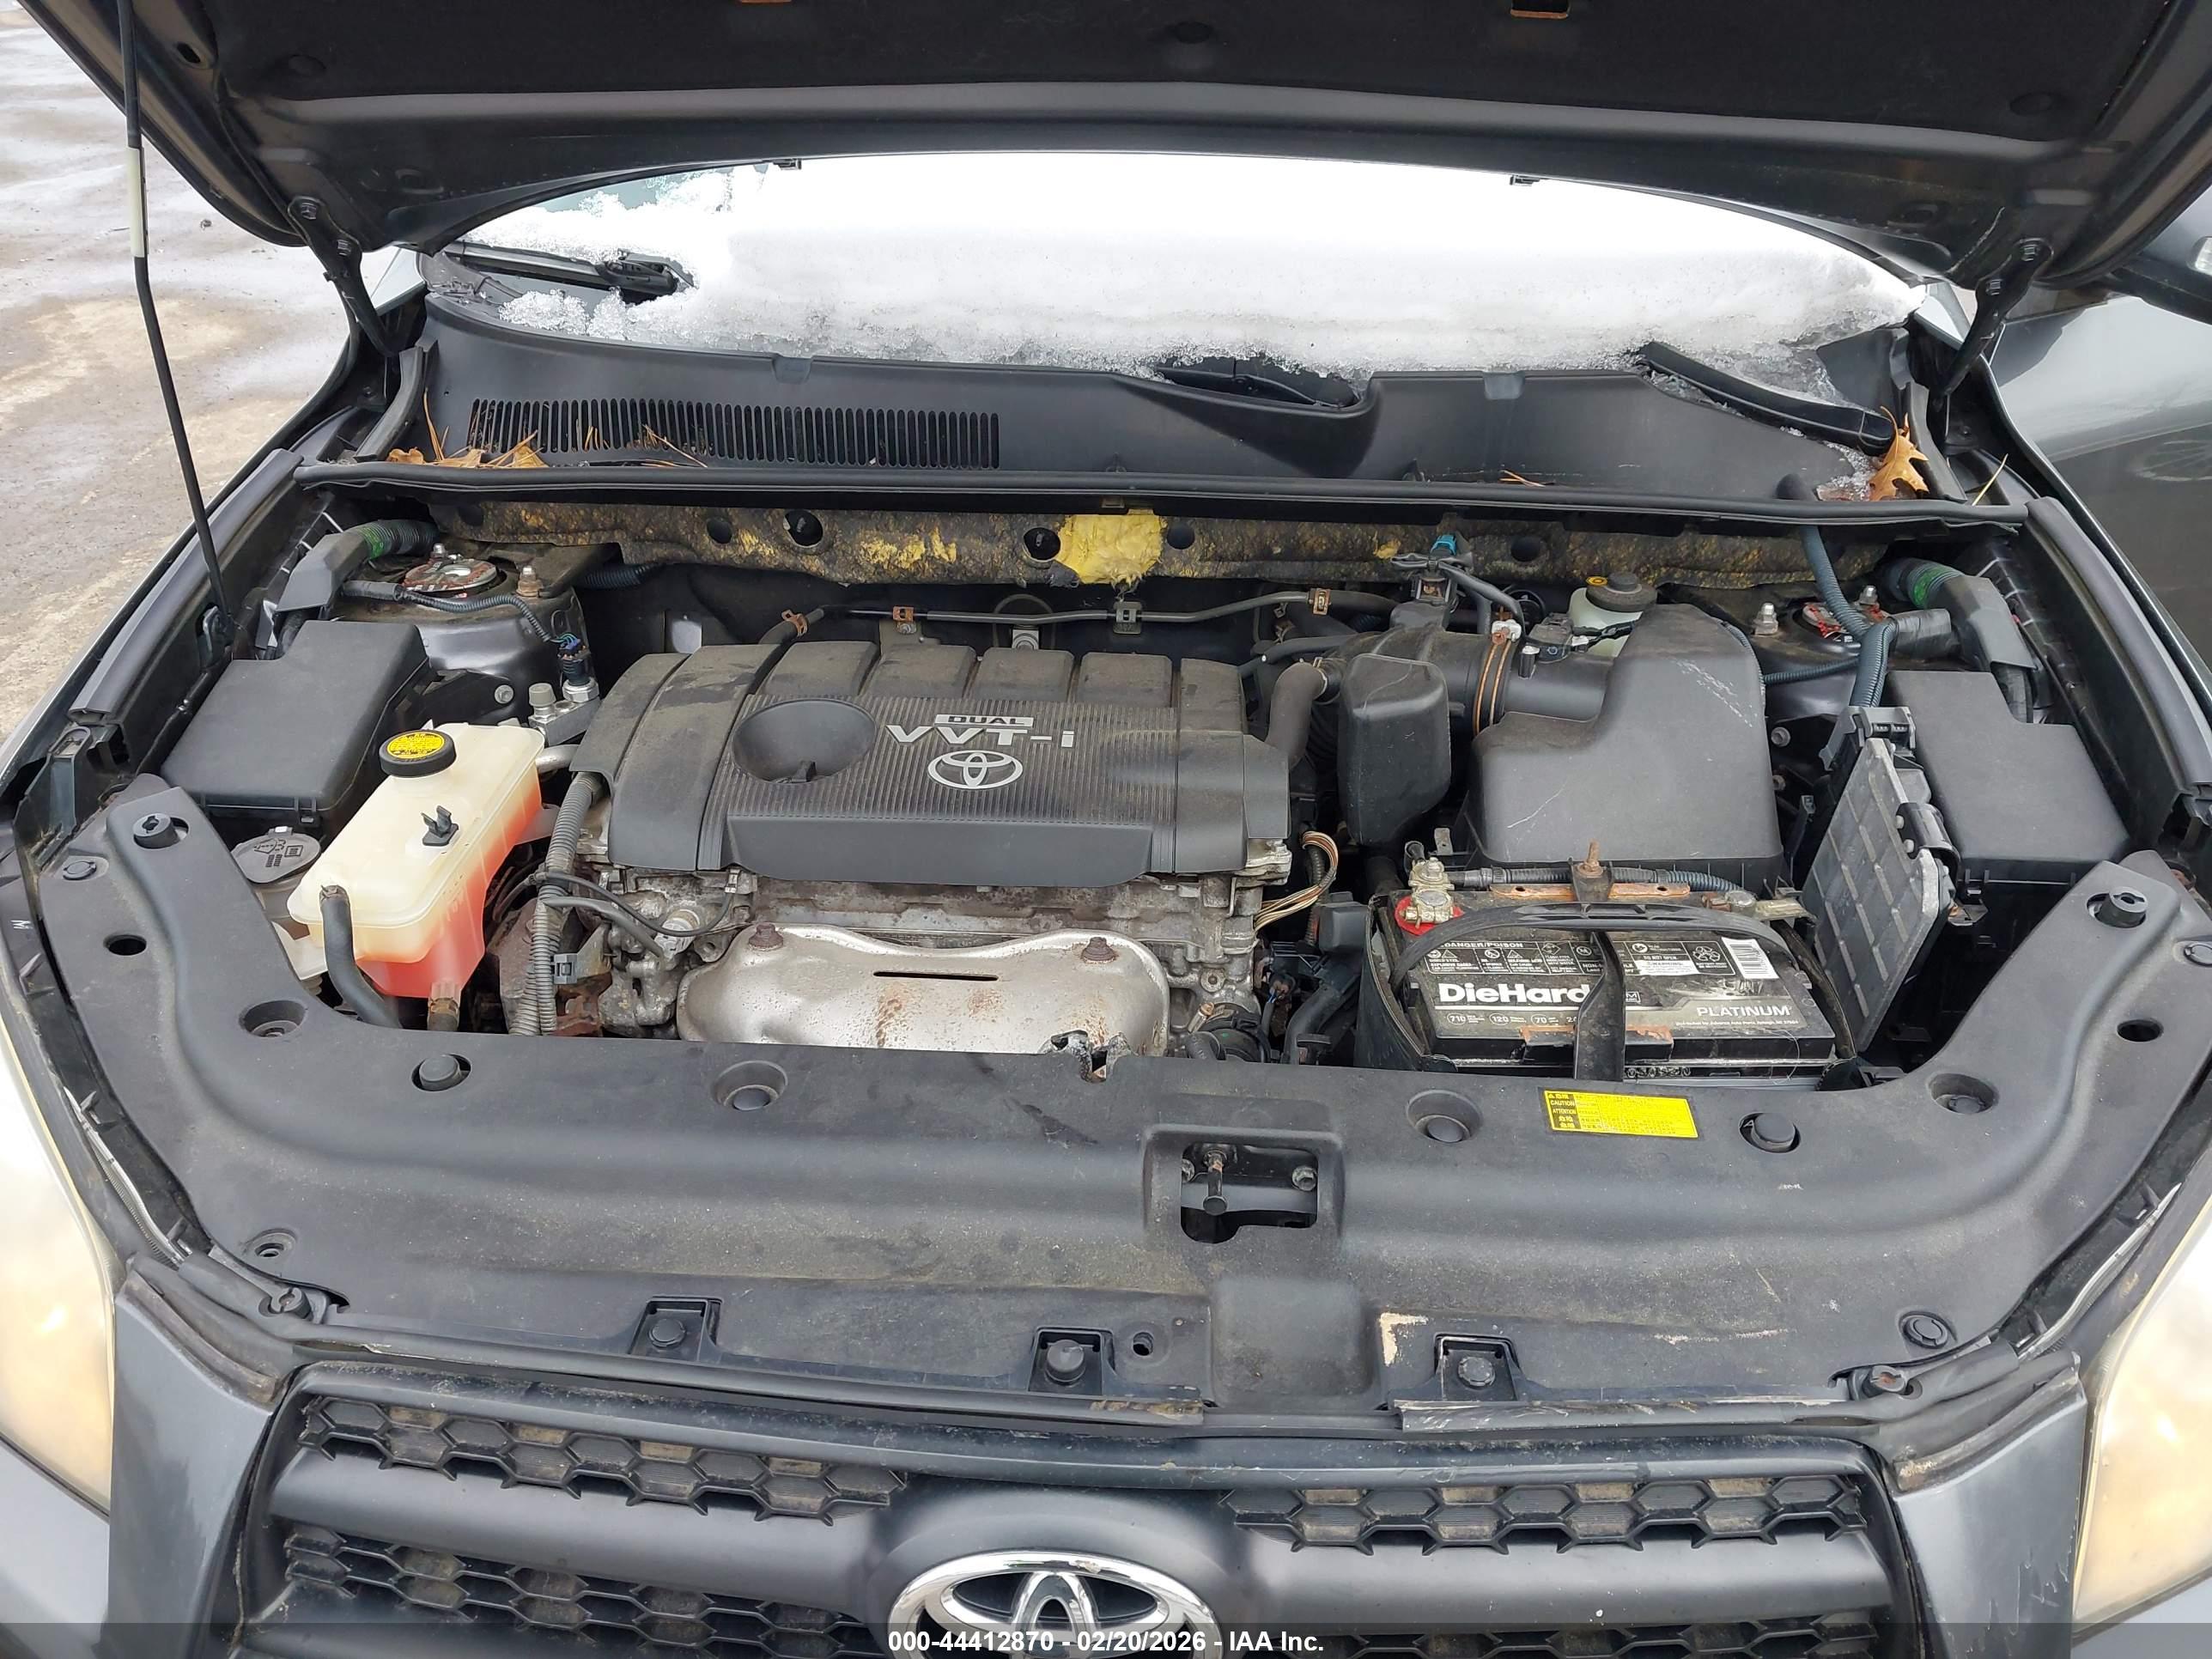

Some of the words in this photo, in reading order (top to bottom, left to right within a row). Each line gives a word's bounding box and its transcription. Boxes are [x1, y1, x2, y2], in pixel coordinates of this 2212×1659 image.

[947, 715, 1025, 725] DUAL
[886, 725, 1075, 748] VVT-i
[1437, 982, 1590, 1004] DieHard
[1697, 1006, 1790, 1017] PLATINUM
